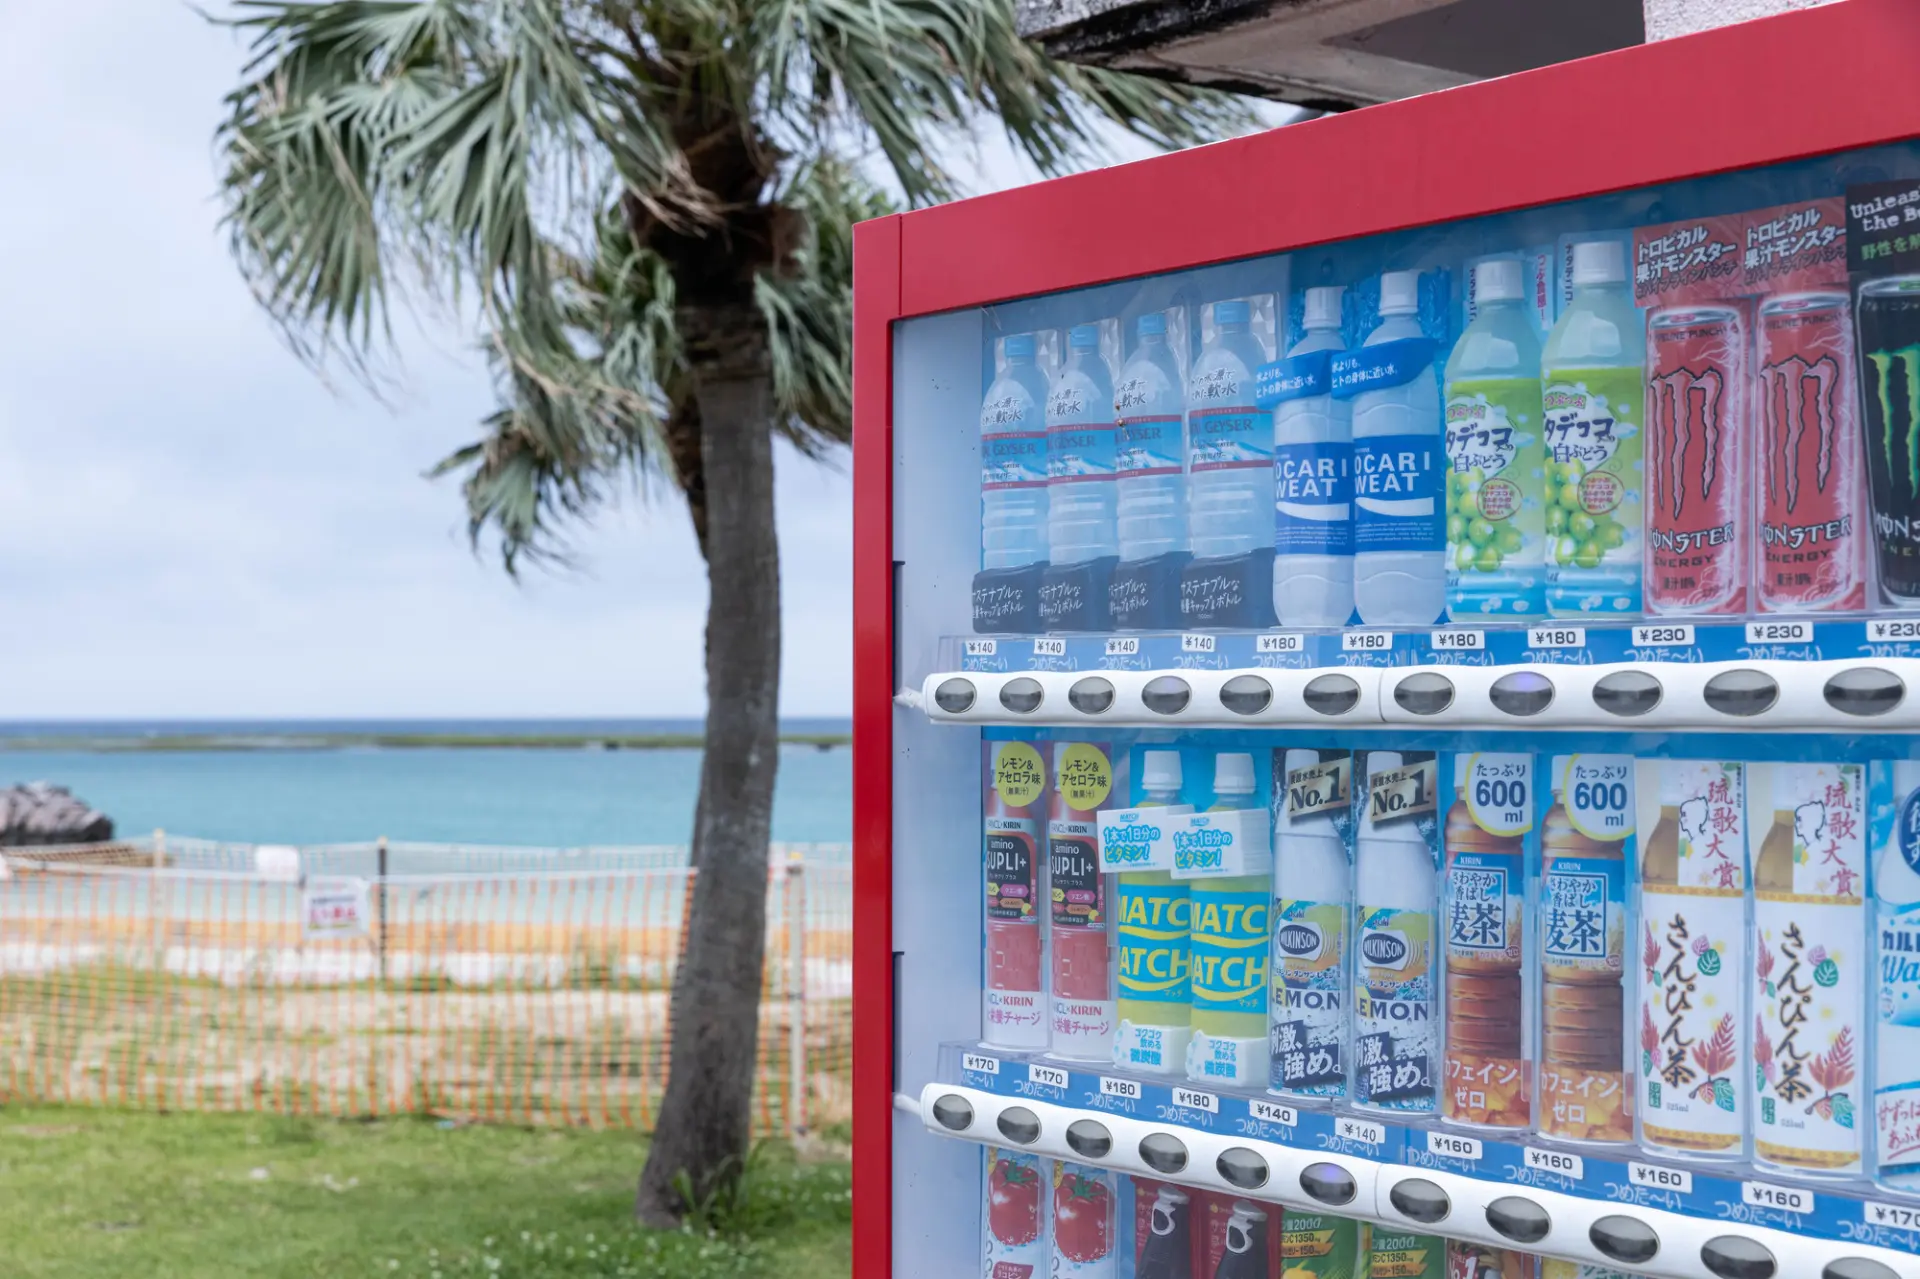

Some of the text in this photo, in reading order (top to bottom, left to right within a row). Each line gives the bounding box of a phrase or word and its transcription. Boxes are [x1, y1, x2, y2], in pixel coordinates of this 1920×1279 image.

[1850, 185, 1920, 219] Unleas
[1747, 207, 1822, 248] トロピカル
[1862, 214, 1899, 232] the
[1638, 225, 1709, 263] トロピカル
[1744, 225, 1847, 270] 果汁モンスター
[1636, 242, 1738, 284] 果汁モンスター
[1204, 418, 1255, 435] GEYSER
[992, 442, 1037, 457] GEYSER
[1053, 435, 1096, 450] GEYSER
[1553, 443, 1608, 464] 白ぶどう
[1453, 454, 1506, 473] 白ぶどう
[972, 584, 1023, 604] ステナブルな
[1438, 633, 1477, 647] ¥180
[1535, 631, 1577, 644] ¥180
[1639, 628, 1686, 642] ¥230
[1753, 625, 1803, 639] ¥230
[968, 642, 993, 654] ¥140
[1037, 641, 1062, 653] ¥140
[1108, 641, 1135, 653] ¥140
[1185, 636, 1212, 650] ¥140
[1264, 637, 1297, 649] ¥180
[1350, 635, 1384, 648] ¥180
[1002, 758, 1034, 770] レモン&
[1065, 759, 1099, 773] レモン&
[1476, 763, 1527, 777] たっぷり
[1575, 765, 1628, 780] たっぷり
[998, 771, 1041, 785] アセロラ味
[1061, 774, 1107, 788] アセロラ味
[1475, 779, 1527, 808] 600
[1575, 782, 1628, 811] 600
[1504, 810, 1524, 824] ml
[1605, 813, 1625, 827] ml
[1103, 825, 1161, 844] 1本で1日分の
[1173, 829, 1233, 849] 1本で1日分の
[1704, 777, 1741, 890] 琉歌大賞
[1820, 780, 1860, 898] 琉歌大賞
[990, 838, 1014, 849] amino
[1055, 843, 1080, 855] amino
[1459, 856, 1483, 866] KIRIN
[1557, 861, 1582, 872] KIRIN
[1452, 871, 1498, 887] さわやか
[1550, 876, 1597, 893] さわやか
[1455, 887, 1492, 902] 香ばし
[1552, 892, 1591, 909] 香ばし
[1450, 900, 1503, 945] 麦茶
[1546, 908, 1603, 953] 麦茶
[1661, 912, 1698, 1089] さんぴん茶
[1773, 921, 1814, 1105] さんぴん茶
[1134, 1027, 1163, 1040] ゴクゴク
[1139, 1038, 1163, 1051] 飲める
[1208, 1039, 1237, 1052] ゴクゴク
[968, 1057, 994, 1071] ¥170
[1129, 1047, 1163, 1067] 微炭酸
[1213, 1050, 1237, 1063] 飲める
[1284, 1048, 1343, 1081] 強め。
[1035, 1068, 1063, 1085] ¥170
[1203, 1060, 1237, 1079] 微炭酸
[1369, 1061, 1432, 1096] 強め。
[1105, 1080, 1136, 1096] ¥180
[1179, 1091, 1211, 1108] ¥180
[1454, 1086, 1486, 1110] ゼロ
[1257, 1103, 1291, 1122] ¥140
[1552, 1100, 1586, 1124] ゼロ
[1344, 1123, 1377, 1142] ¥140
[1434, 1137, 1473, 1155] ¥160
[1531, 1152, 1573, 1170] ¥160
[1637, 1167, 1682, 1186] ¥160
[1753, 1186, 1801, 1208] ¥160
